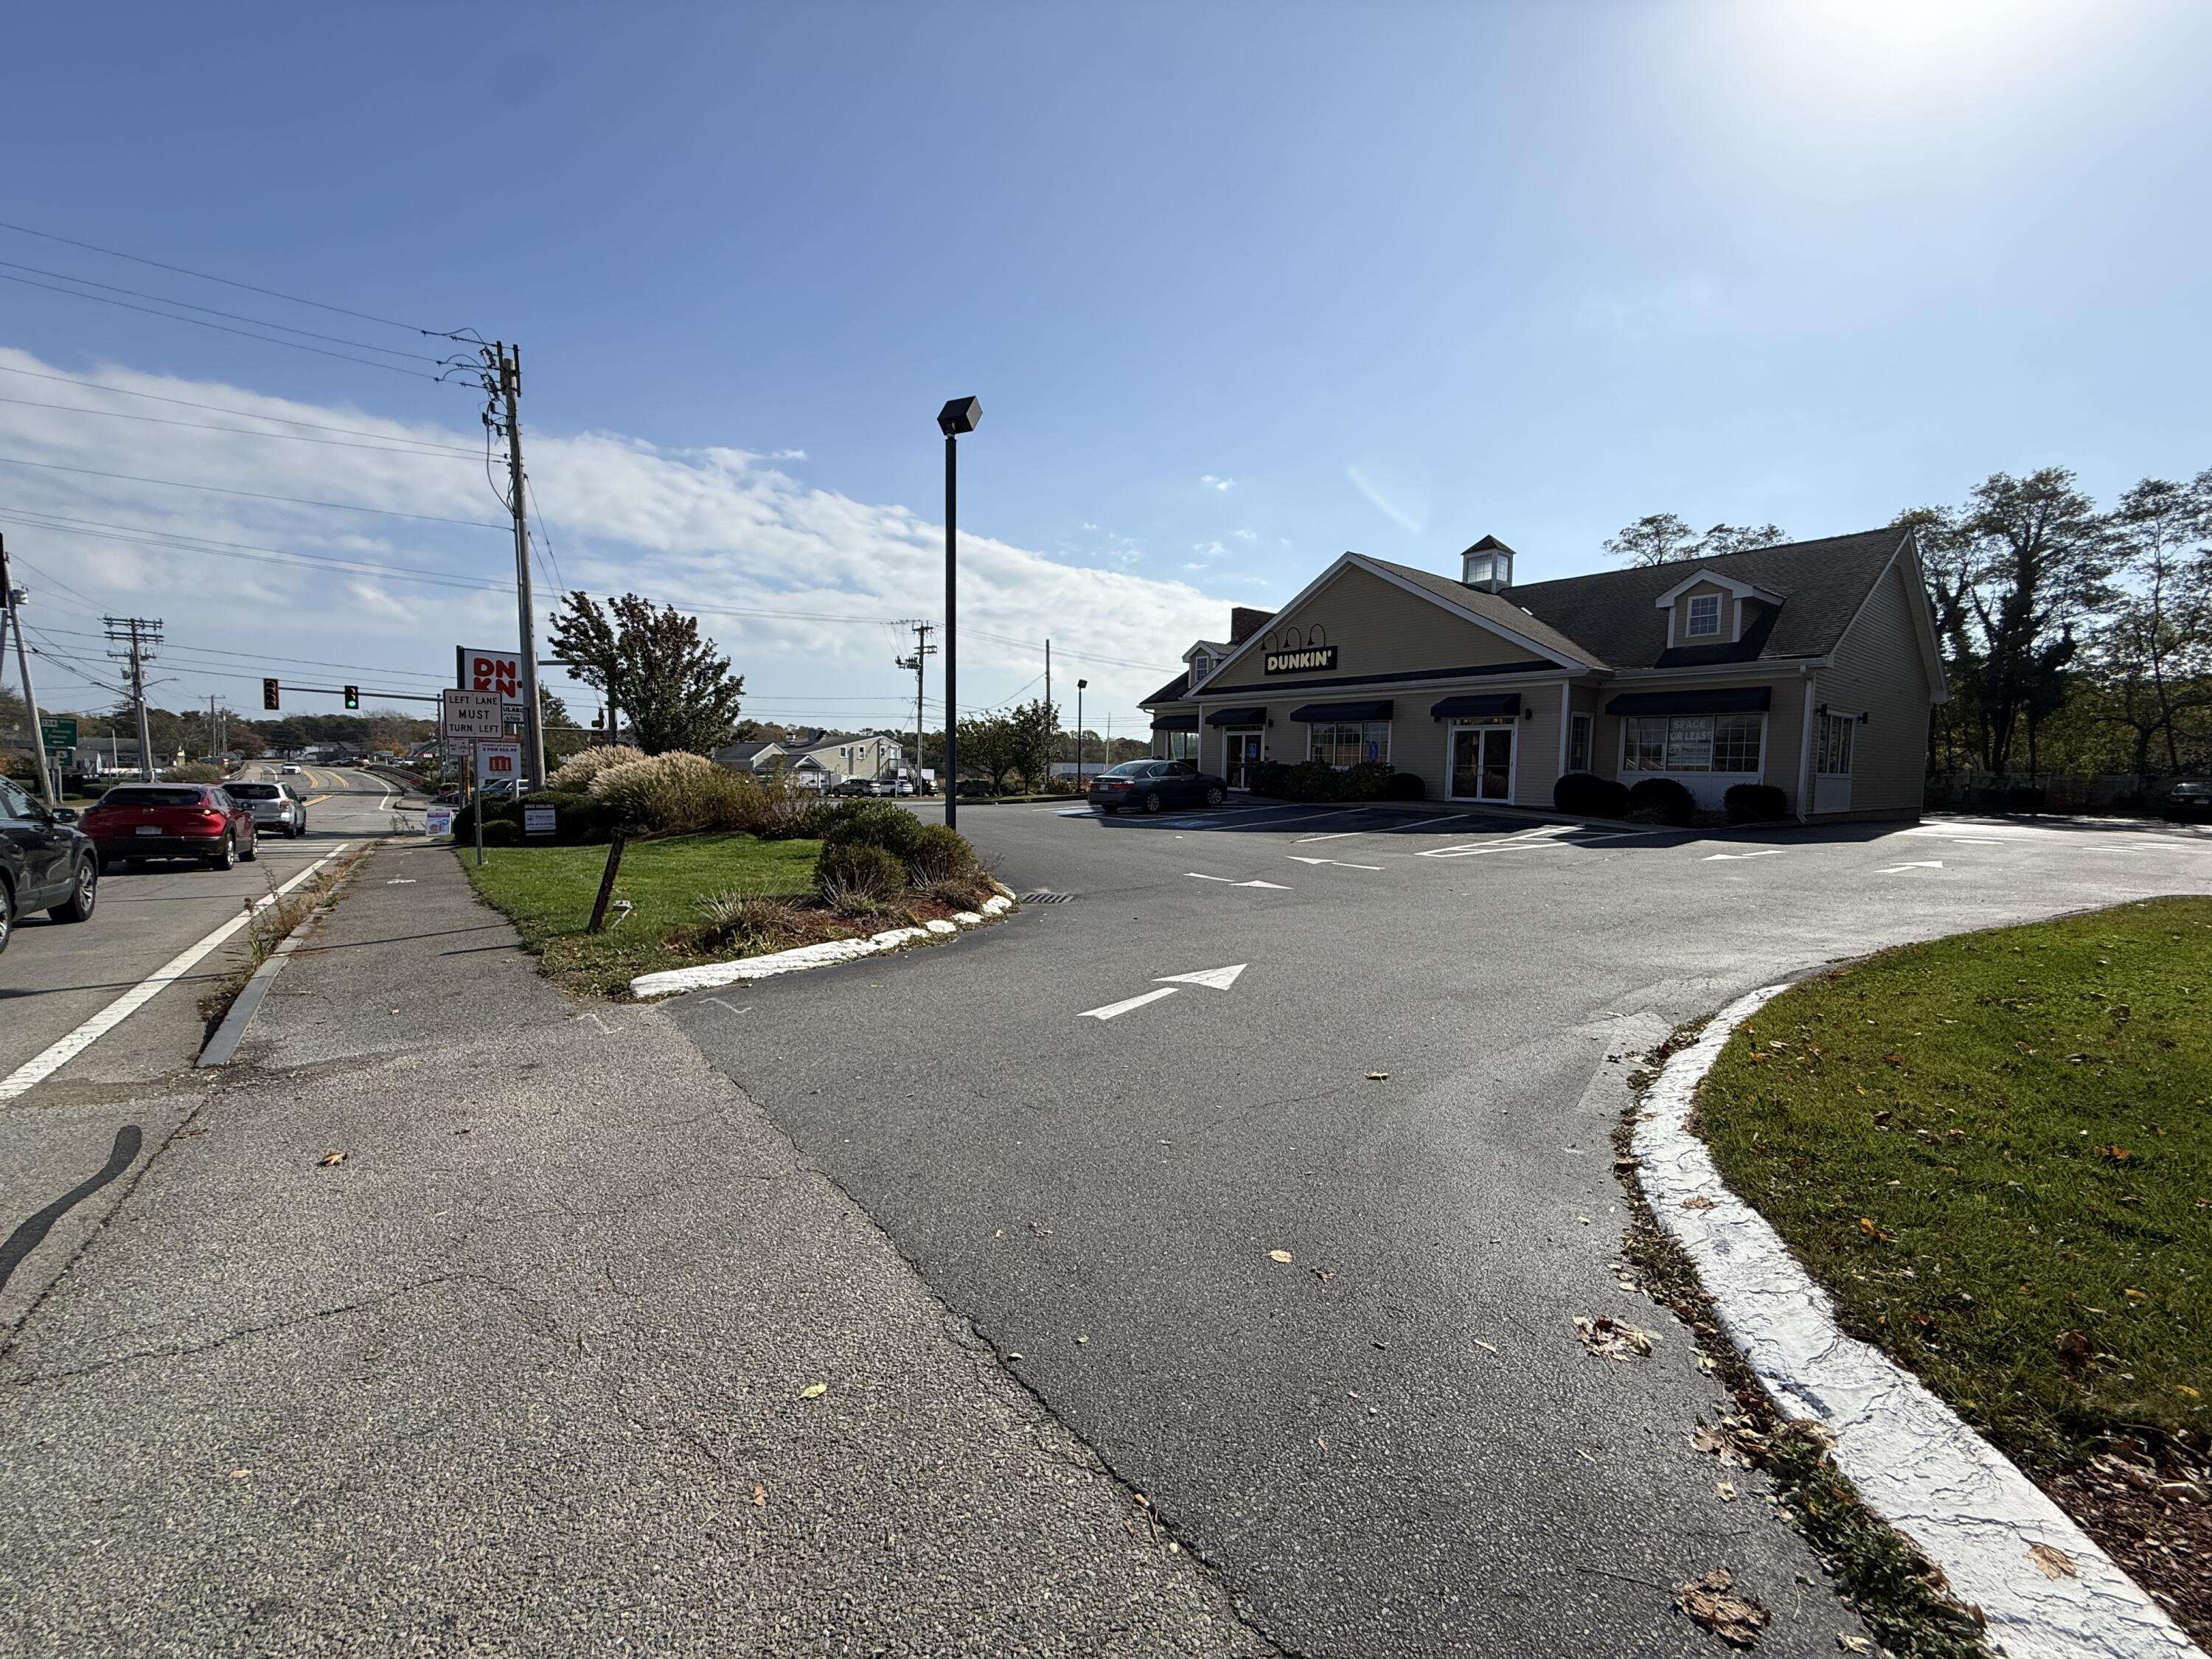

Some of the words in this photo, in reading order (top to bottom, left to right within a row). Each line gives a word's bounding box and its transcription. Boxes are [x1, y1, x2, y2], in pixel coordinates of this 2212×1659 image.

[1267, 650, 1332, 671] DUNKIN'
[473, 658, 516, 679] DN
[449, 695, 470, 704] LEFT
[476, 697, 498, 705] LANE
[458, 709, 490, 720] MUST
[449, 723, 473, 732] TURN
[479, 725, 499, 733] LEFT
[1674, 720, 1705, 728] SPACE
